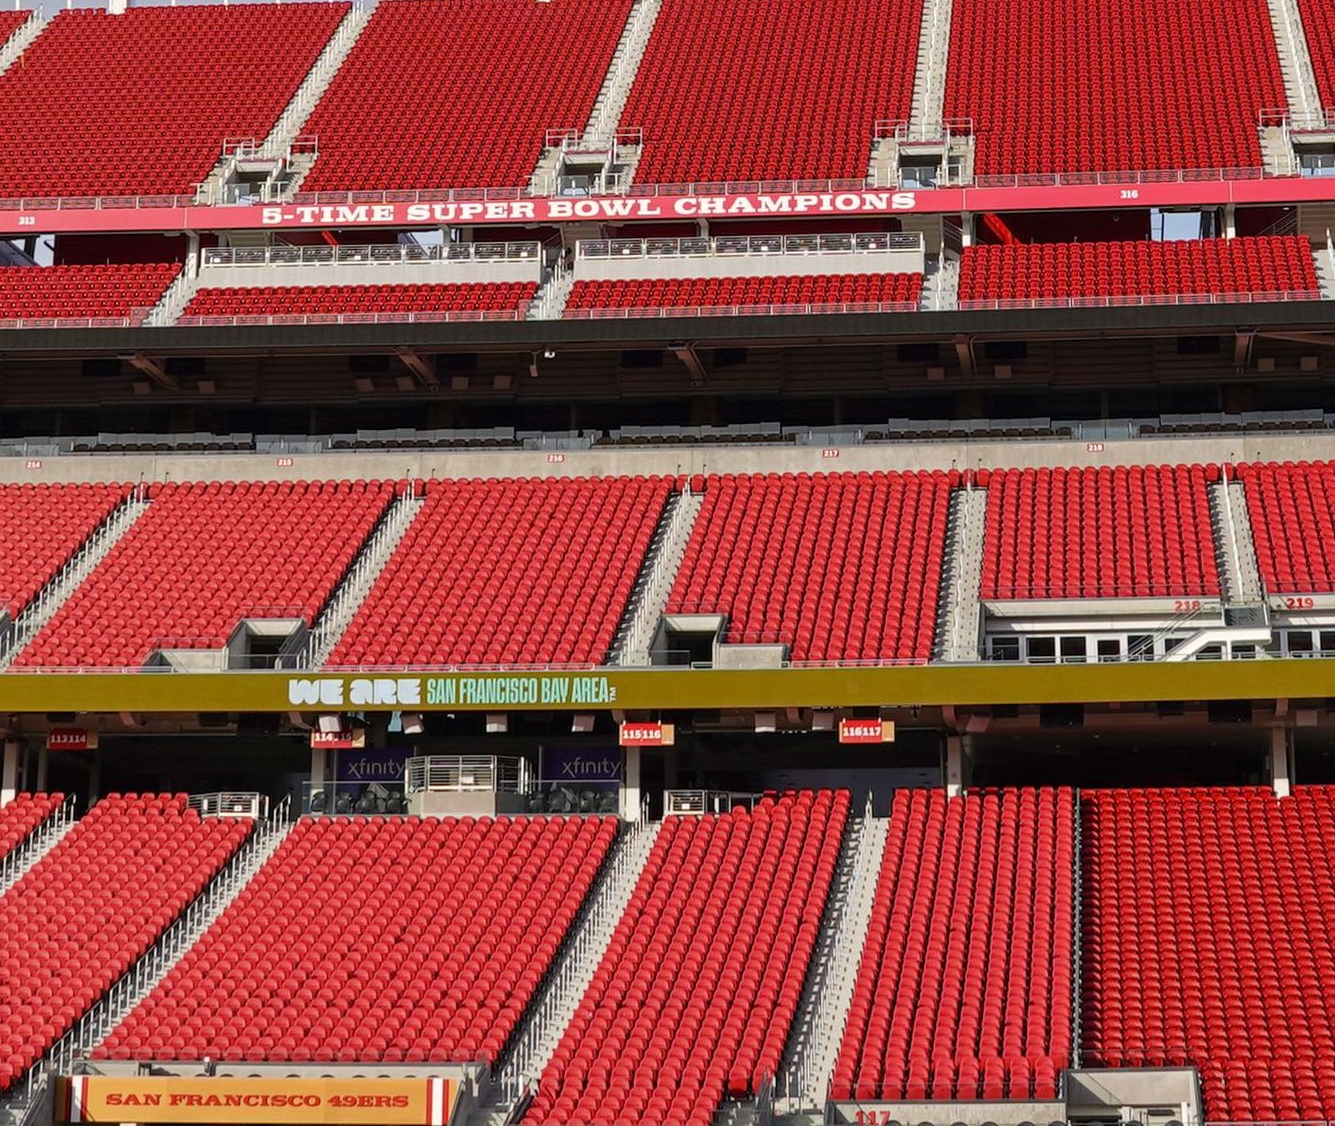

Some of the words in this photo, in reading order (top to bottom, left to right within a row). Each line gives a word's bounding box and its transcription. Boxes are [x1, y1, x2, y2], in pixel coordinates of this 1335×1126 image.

[1120, 189, 1138, 199] 316
[261, 205, 394, 224] 5-TIME
[406, 201, 535, 222] SUPER
[547, 198, 661, 218] BOWL
[673, 192, 916, 216] CHAMPIONS
[1286, 597, 1314, 609] 219
[288, 679, 344, 704] WE
[427, 678, 457, 704] SAN
[459, 677, 538, 704] FRANCISCO
[540, 677, 570, 703] BAY
[571, 677, 609, 703] AREA
[348, 758, 405, 778] xfinity
[562, 757, 621, 778] xfinity
[106, 1093, 162, 1106] SAN
[168, 1094, 321, 1107] FRANCISCO
[327, 1095, 409, 1108] 49ERS
[856, 1110, 890, 1126] 117
